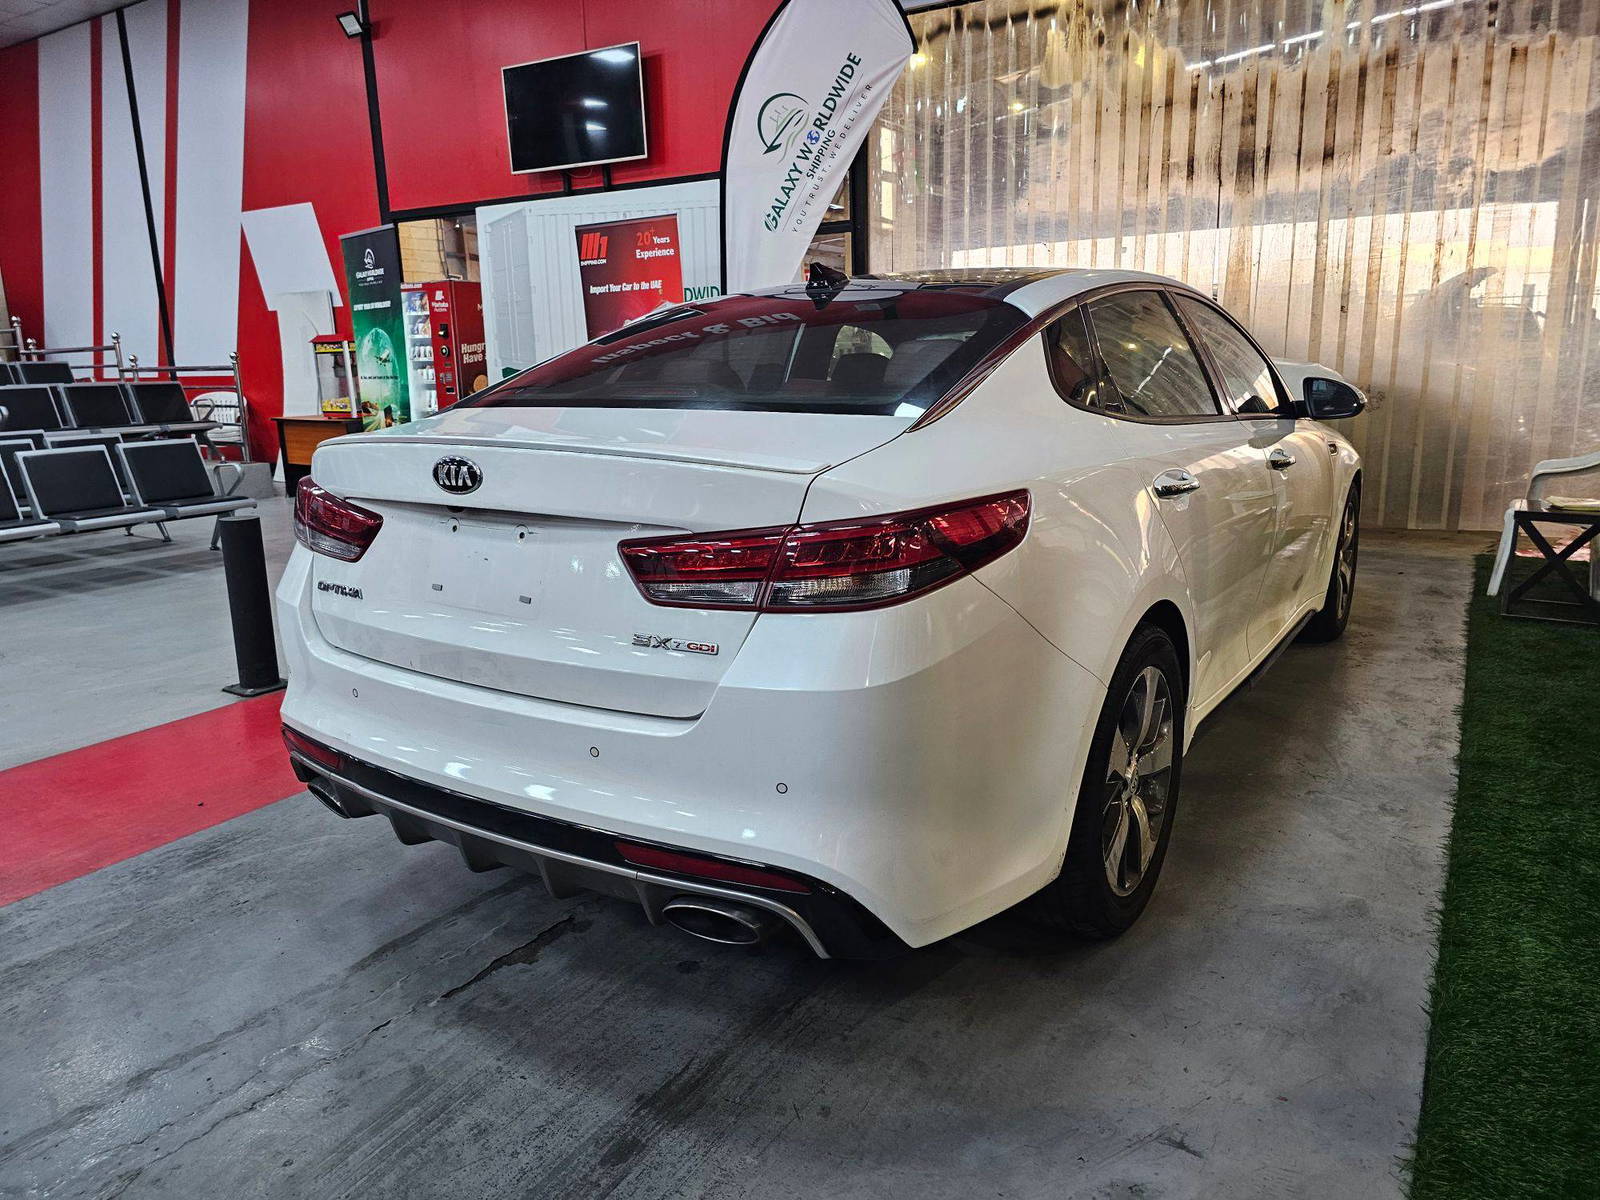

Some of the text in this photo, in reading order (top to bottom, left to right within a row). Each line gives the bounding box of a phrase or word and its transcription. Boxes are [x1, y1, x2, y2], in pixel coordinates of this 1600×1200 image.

[806, 129, 836, 180] SHIPPING
[764, 162, 803, 232] GALAXY
[652, 236, 671, 245] Years
[635, 247, 675, 260] Experience
[589, 280, 663, 295] Import Your Car to the UAE
[463, 354, 484, 364] Have
[437, 464, 473, 487] KIA
[632, 633, 672, 650] SX
